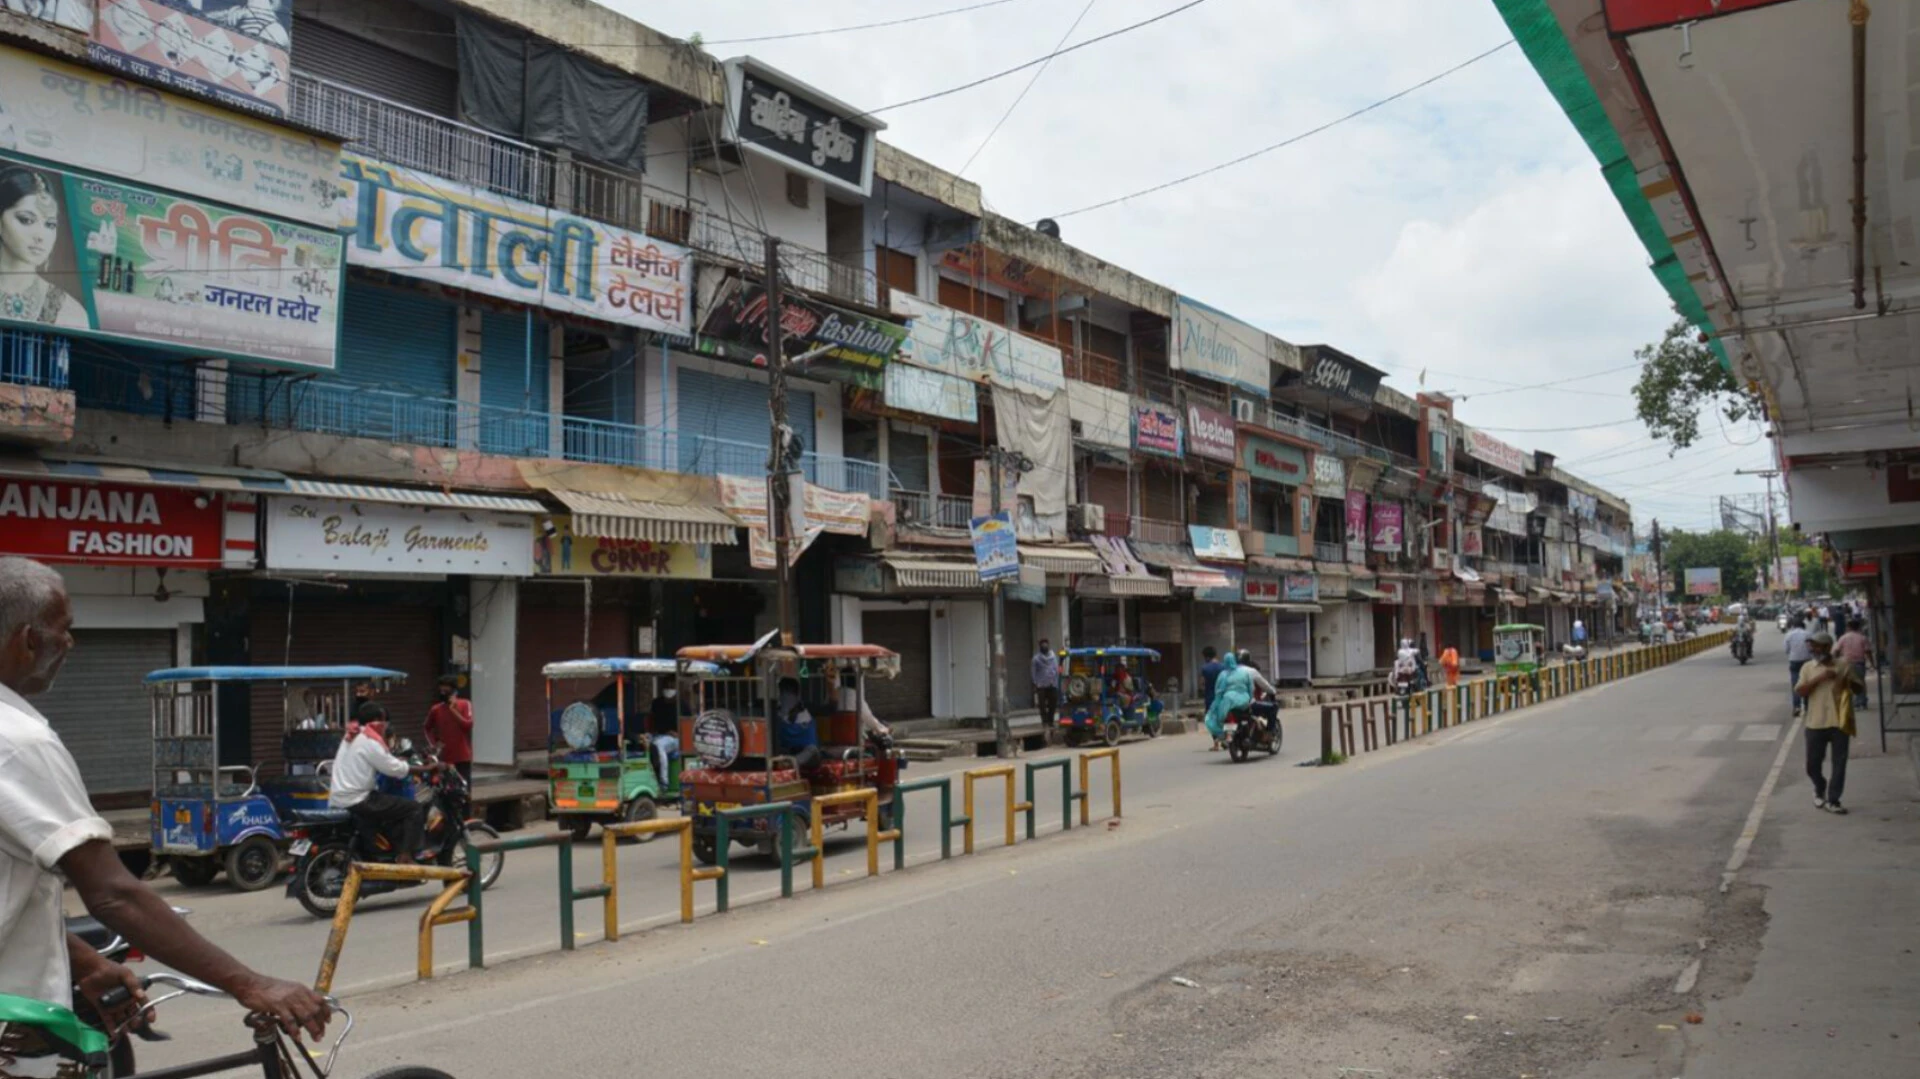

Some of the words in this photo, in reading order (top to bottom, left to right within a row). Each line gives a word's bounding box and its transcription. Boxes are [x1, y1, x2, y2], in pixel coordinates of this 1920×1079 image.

[175, 106, 276, 153] जनरल
[205, 284, 273, 315] जनरल
[276, 295, 321, 323] स्टोर
[608, 273, 685, 322] टेलर्स
[816, 313, 897, 350] fashion
[1188, 406, 1234, 447] Neelam
[0, 483, 162, 525] ANJANA
[68, 530, 193, 557] FASHION
[322, 515, 391, 555] Balaji
[404, 524, 489, 553] Garments
[241, 814, 274, 826] KHALSA
